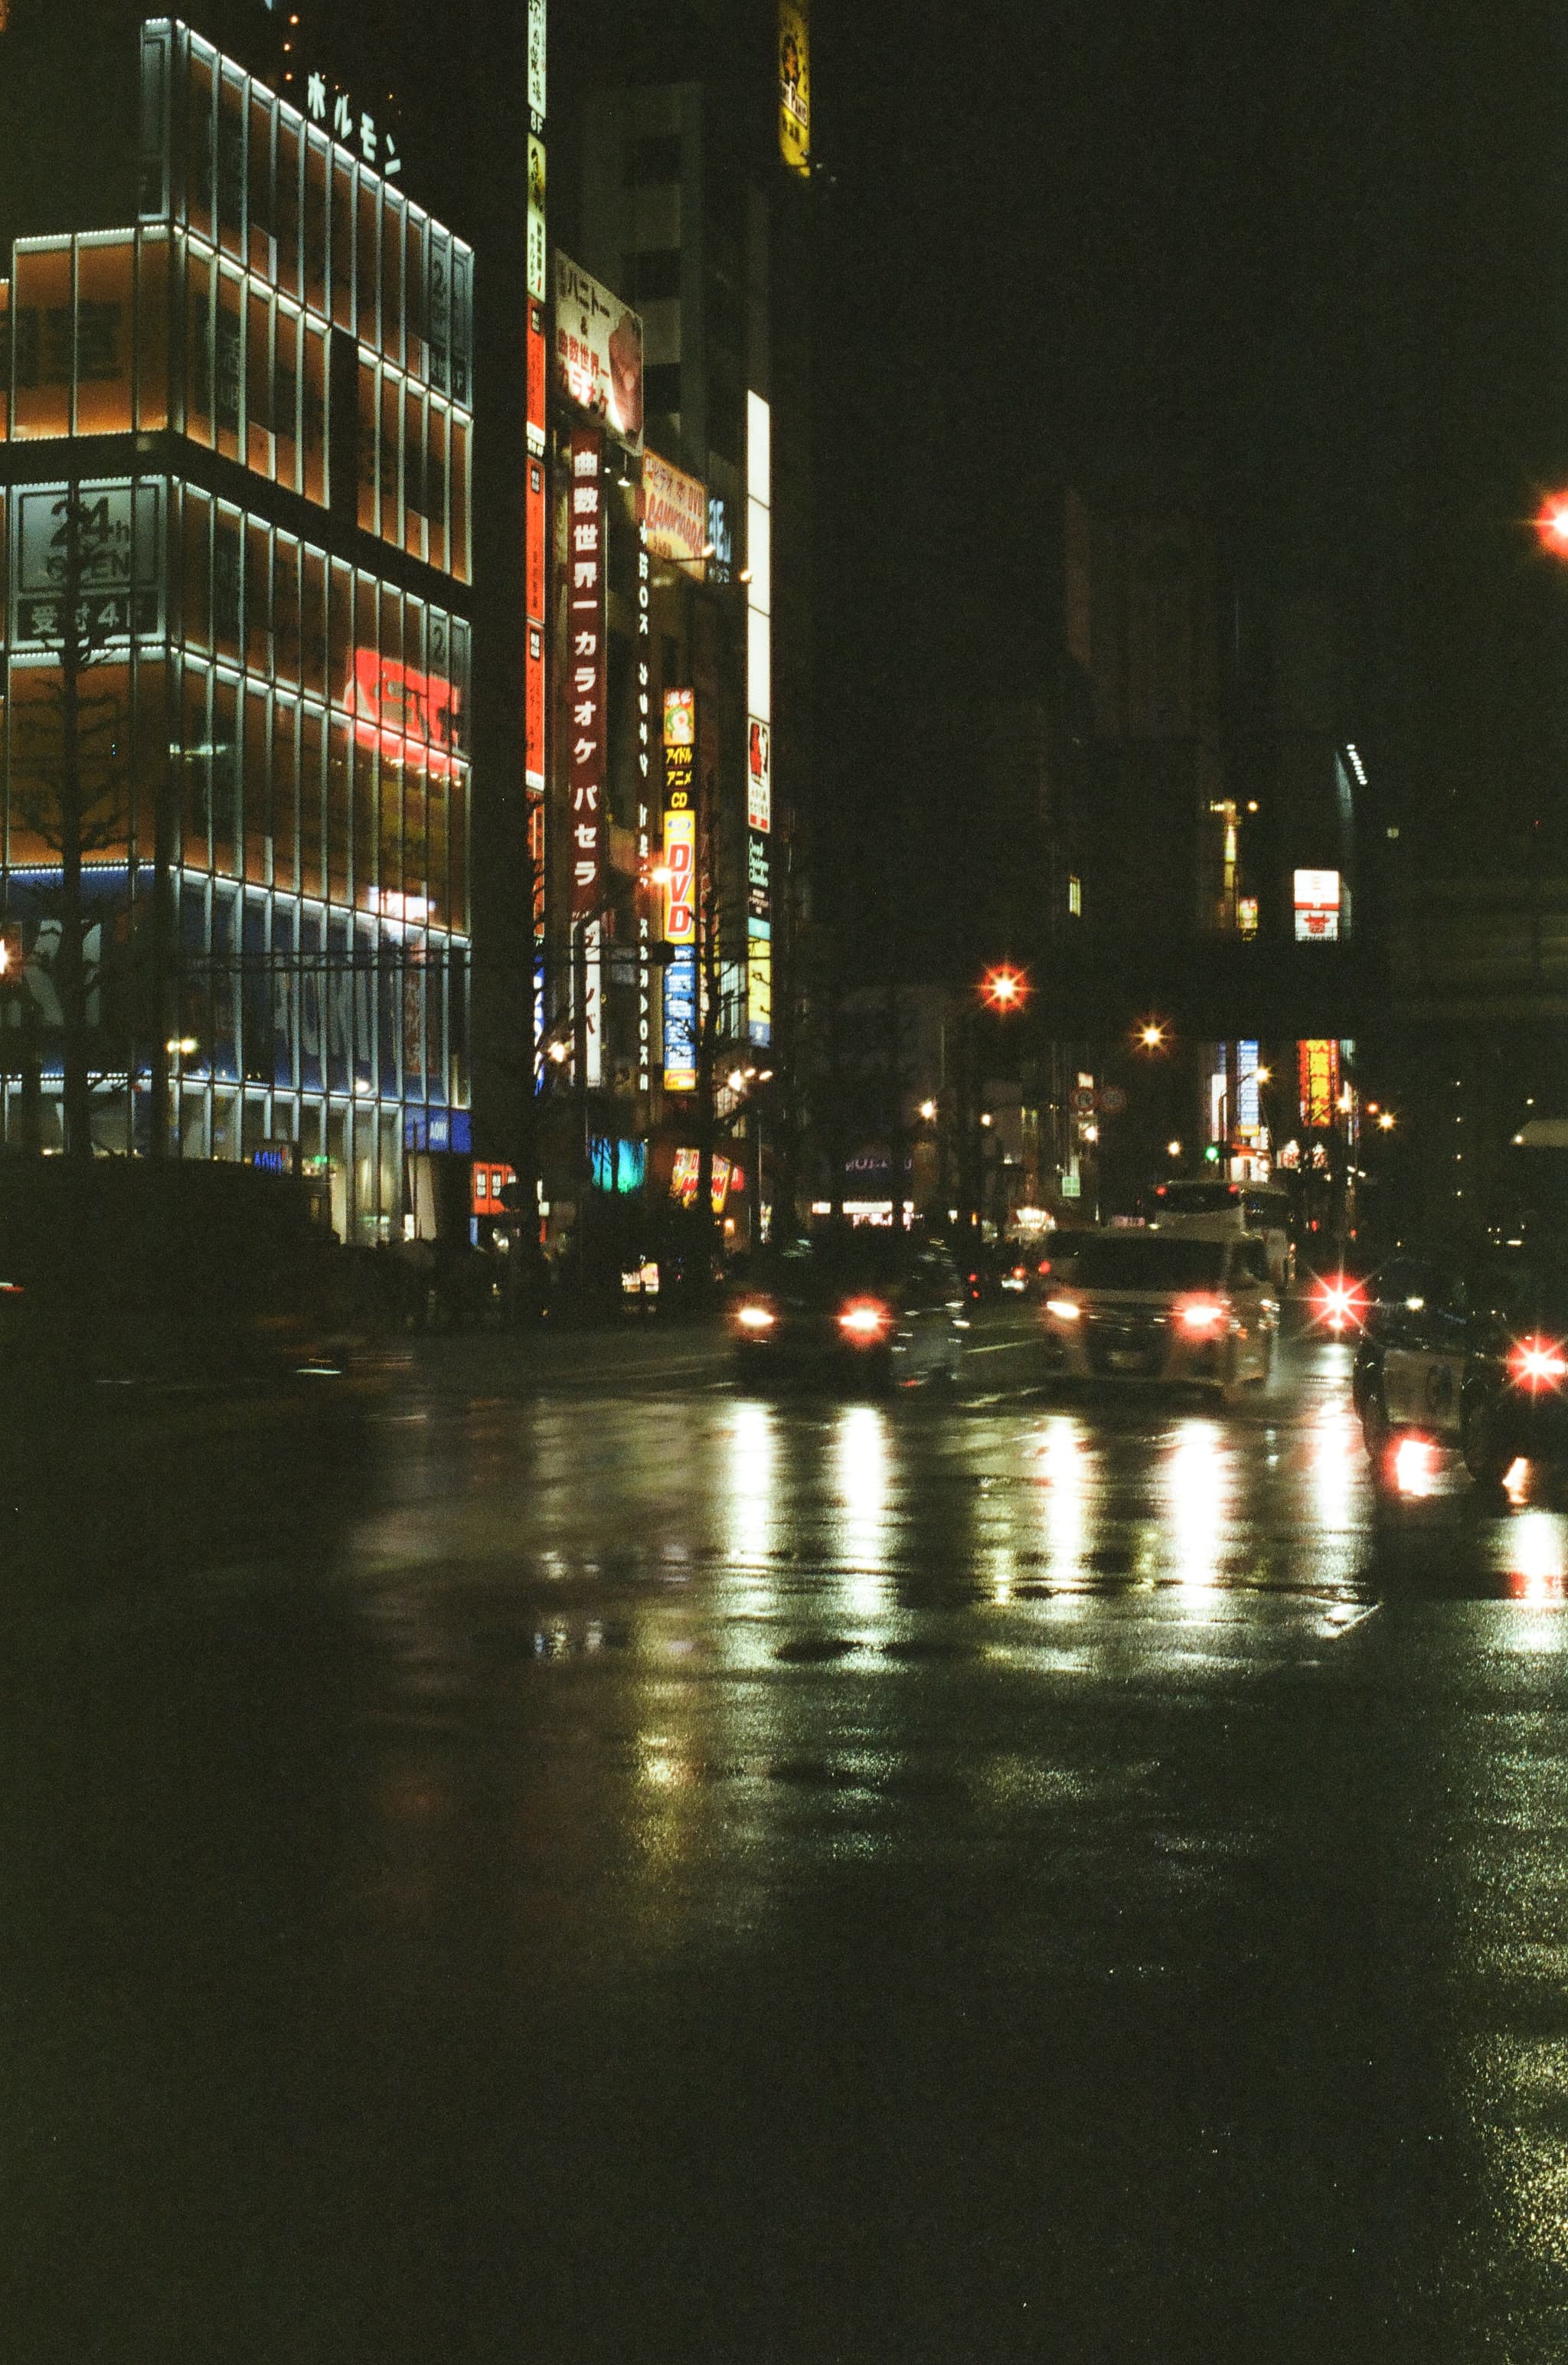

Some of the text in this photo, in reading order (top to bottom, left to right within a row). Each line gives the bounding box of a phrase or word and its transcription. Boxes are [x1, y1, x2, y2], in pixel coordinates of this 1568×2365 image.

[308, 71, 402, 176] ホルモン
[665, 746, 692, 765] アイドル
[666, 770, 692, 786] アニメ
[671, 792, 688, 808] CD
[573, 784, 598, 887] パセラ
[668, 842, 693, 936] DVD
